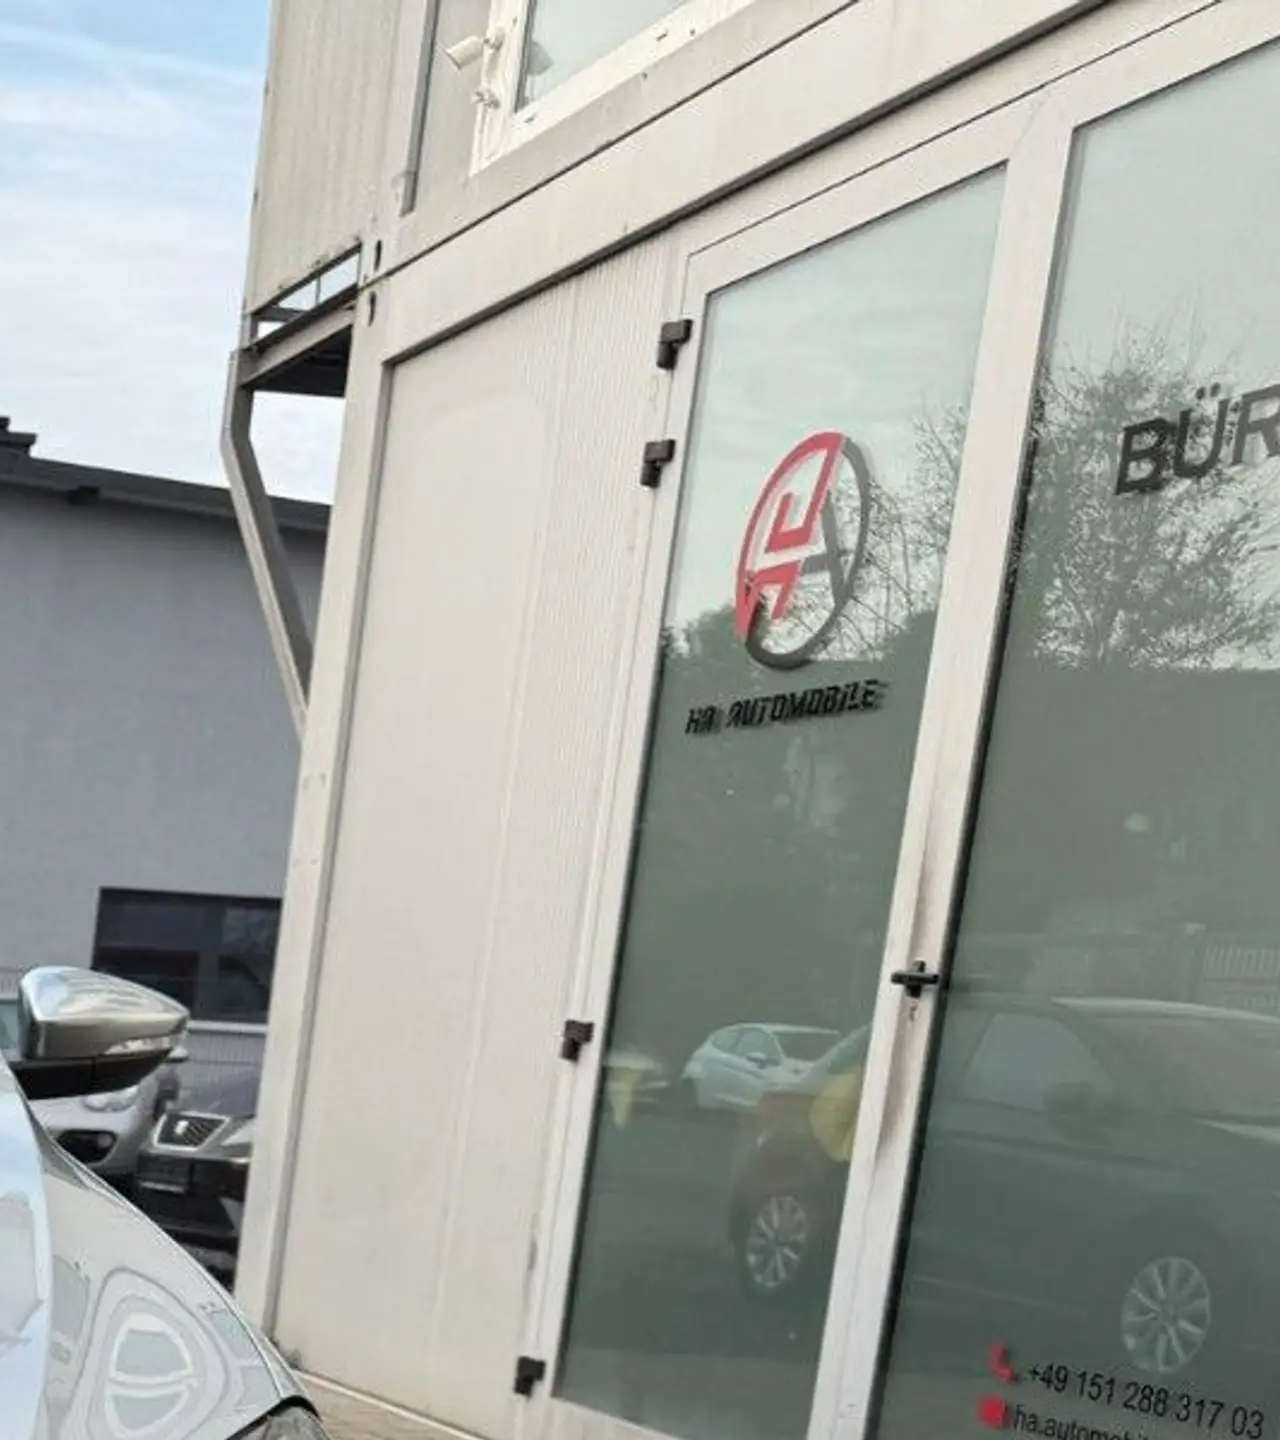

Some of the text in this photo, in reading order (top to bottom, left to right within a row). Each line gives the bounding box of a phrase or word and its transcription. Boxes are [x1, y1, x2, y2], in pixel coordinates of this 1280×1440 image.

[685, 679, 882, 735] HA AUTOMOBILE
[1028, 1363, 1264, 1440] +49 151 288 317 03
